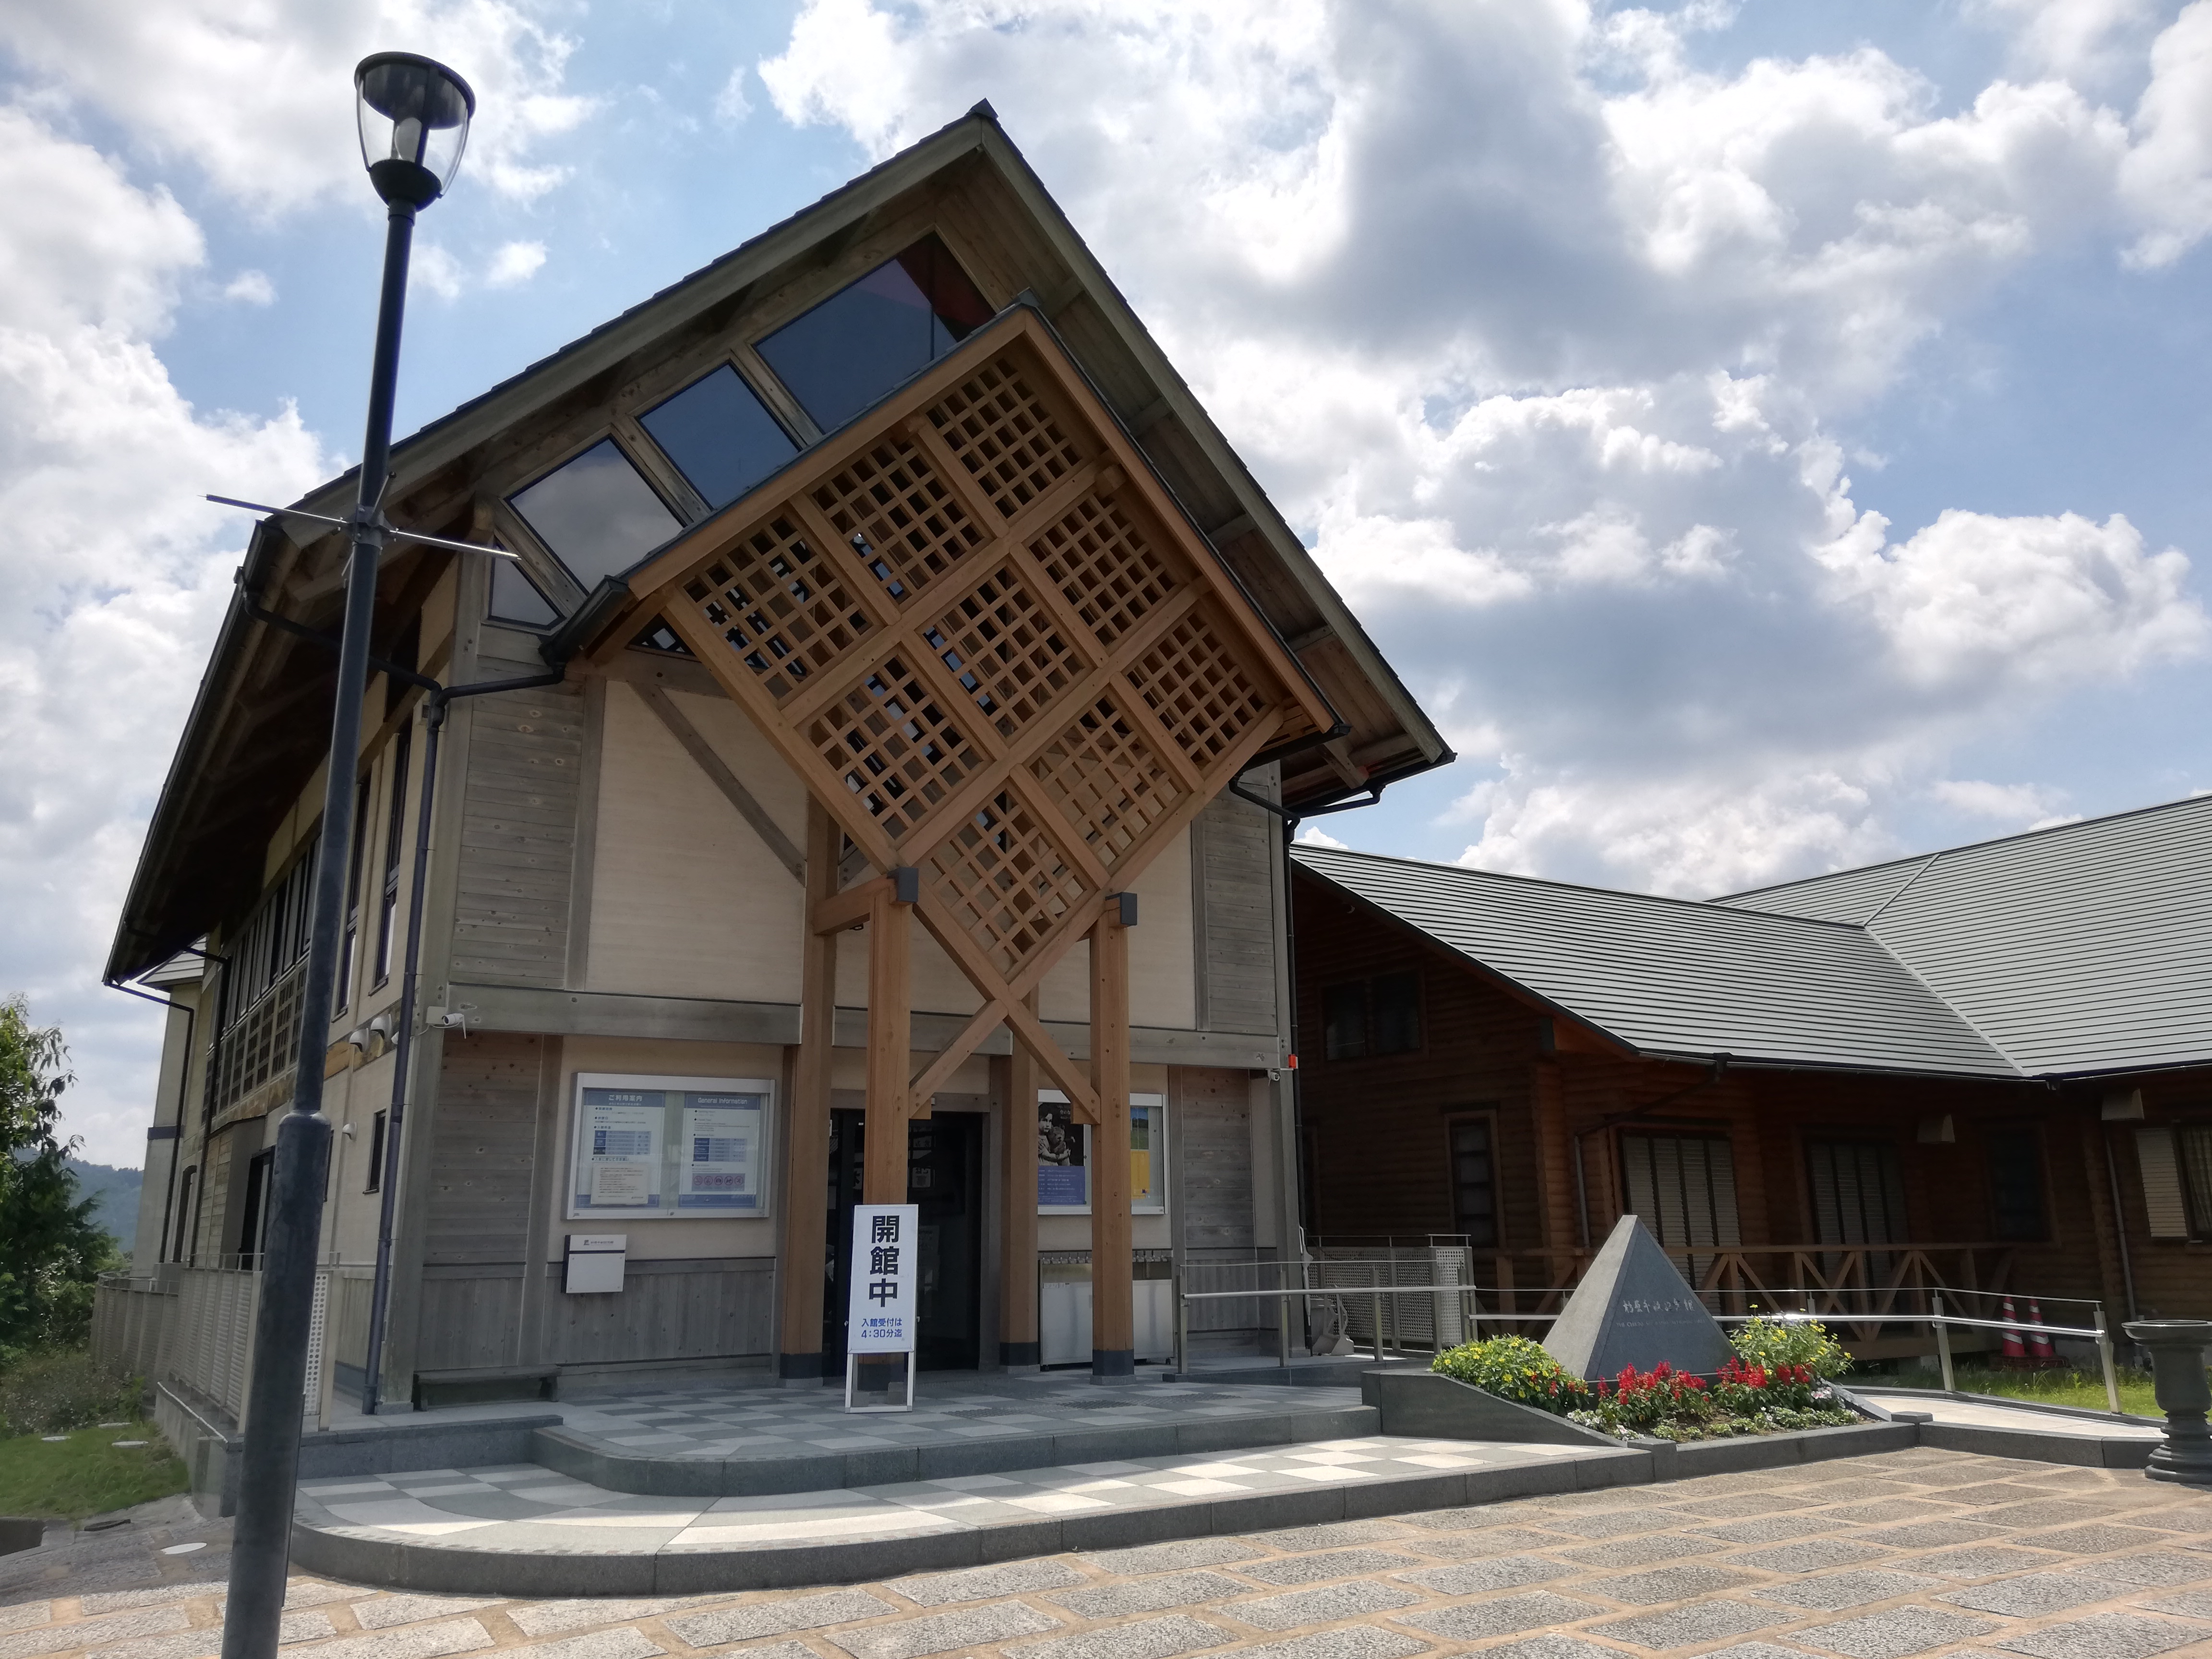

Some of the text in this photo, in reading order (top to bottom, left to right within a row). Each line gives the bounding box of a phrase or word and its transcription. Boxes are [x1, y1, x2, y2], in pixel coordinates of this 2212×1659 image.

[868, 1215, 900, 1308] 開館中
[861, 1318, 902, 1327] 入館受付は
